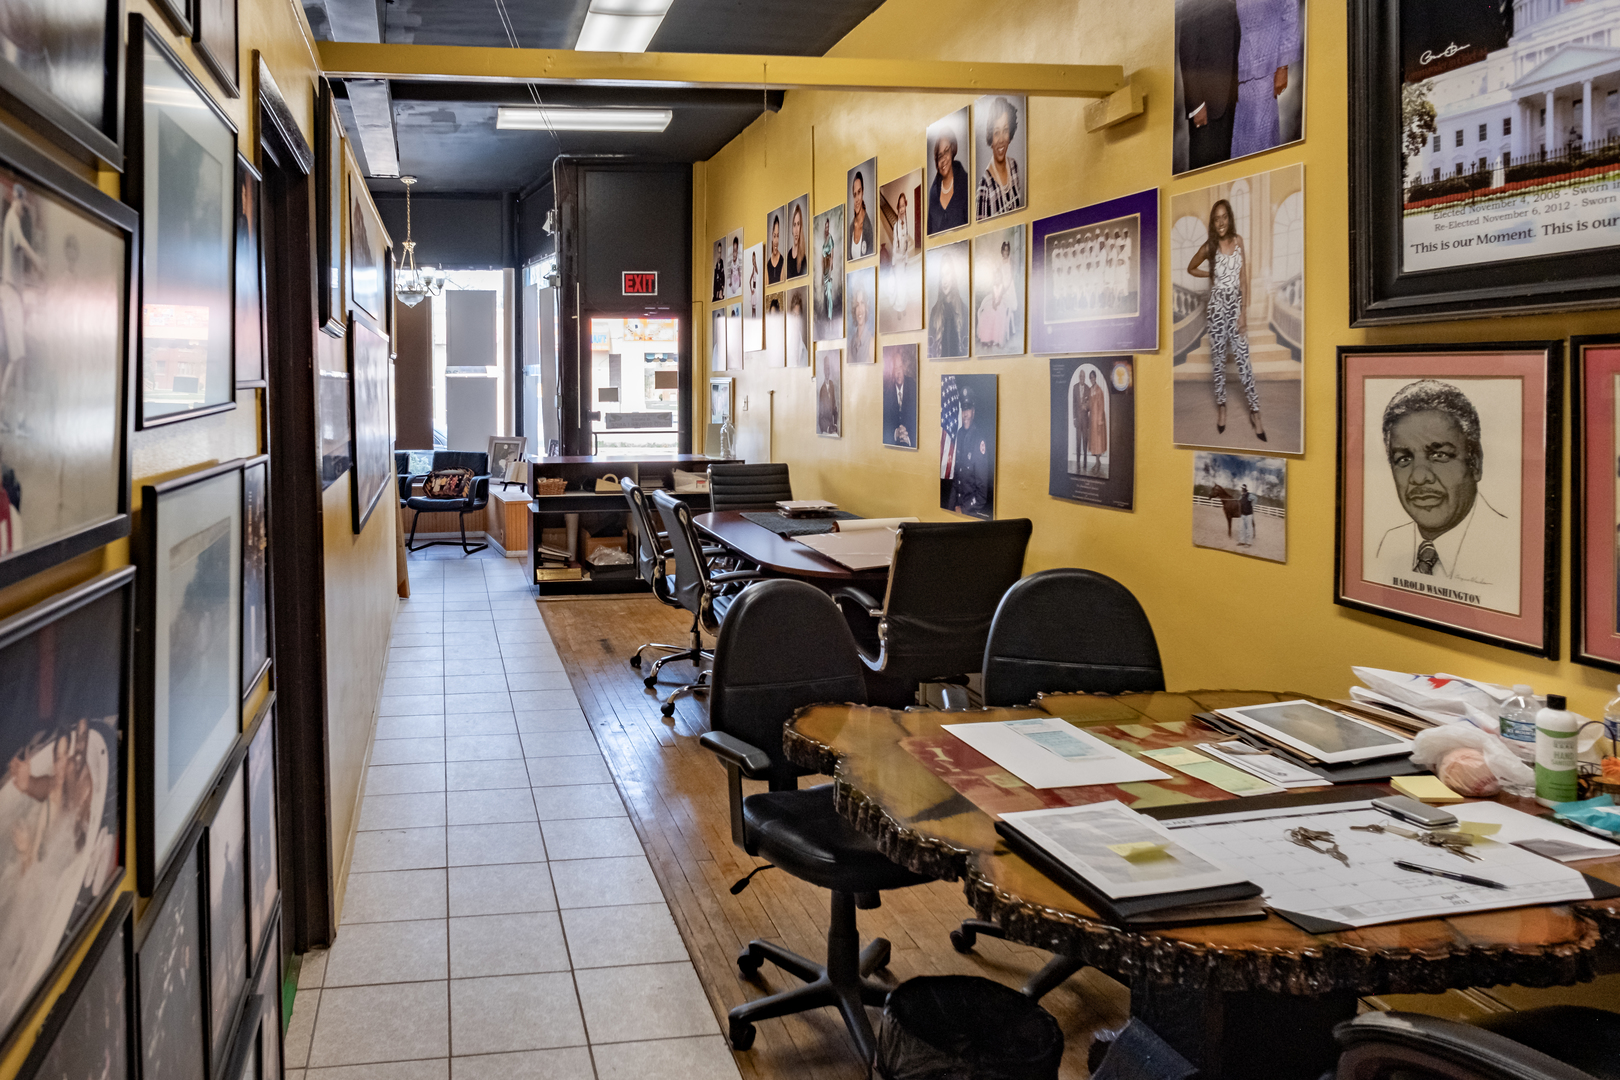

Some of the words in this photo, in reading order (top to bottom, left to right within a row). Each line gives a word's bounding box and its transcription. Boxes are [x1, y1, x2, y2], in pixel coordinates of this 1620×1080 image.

[1433, 207, 1466, 220] Elected
[1469, 199, 1517, 214] November
[1533, 190, 1560, 203] 2008
[1572, 183, 1609, 196] Sworn
[1434, 217, 1479, 231] Re-Elected
[1482, 210, 1529, 224] November
[1544, 201, 1571, 214] 2012
[1582, 195, 1617, 207] Sworn
[1440, 240, 1450, 251] is
[1453, 238, 1475, 249] our
[1476, 227, 1537, 246] Moment.
[1541, 222, 1573, 236] This
[1576, 219, 1588, 232] is
[1592, 216, 1620, 229] our
[625, 274, 654, 293] EXIT
[1393, 577, 1425, 592] HAROLD
[1426, 584, 1481, 604] WASHINGTON
[1553, 751, 1575, 760] HAND
